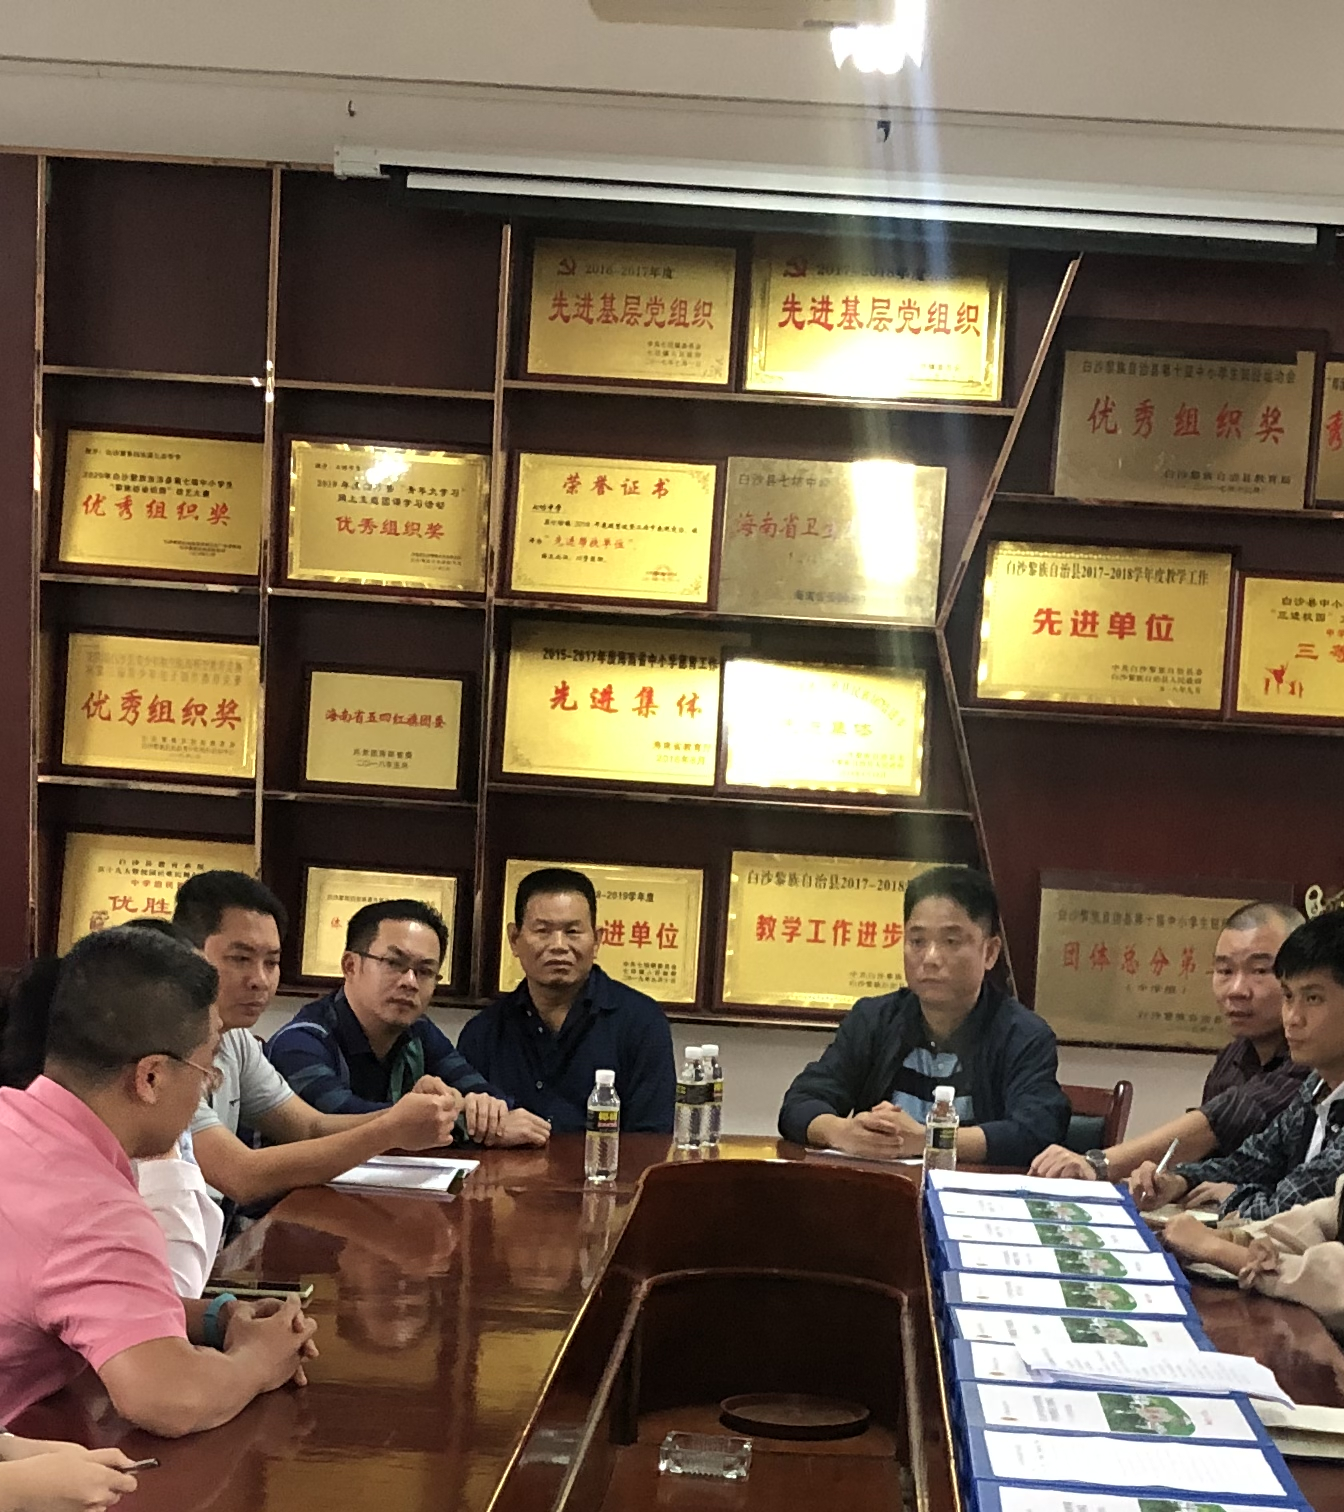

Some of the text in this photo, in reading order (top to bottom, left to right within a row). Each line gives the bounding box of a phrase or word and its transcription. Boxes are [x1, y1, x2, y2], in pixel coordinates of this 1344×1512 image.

[548, 290, 714, 330] 先进基层党组织
[778, 292, 981, 337] 先进基层党组织
[1087, 395, 1285, 445] 优秀组织奖
[563, 472, 671, 499] 荣誉证书
[83, 493, 232, 526] 优秀组织奖
[336, 516, 445, 539] 优秀组织奖
[1032, 608, 1175, 642] 先进单位
[81, 689, 242, 730] 优秀组织奖
[550, 680, 702, 718] 先进集体
[325, 708, 446, 729] 海南省五四红旗团委
[108, 895, 172, 915] 优胜
[601, 919, 679, 950] 进单位
[756, 914, 903, 949] 教学工作进步
